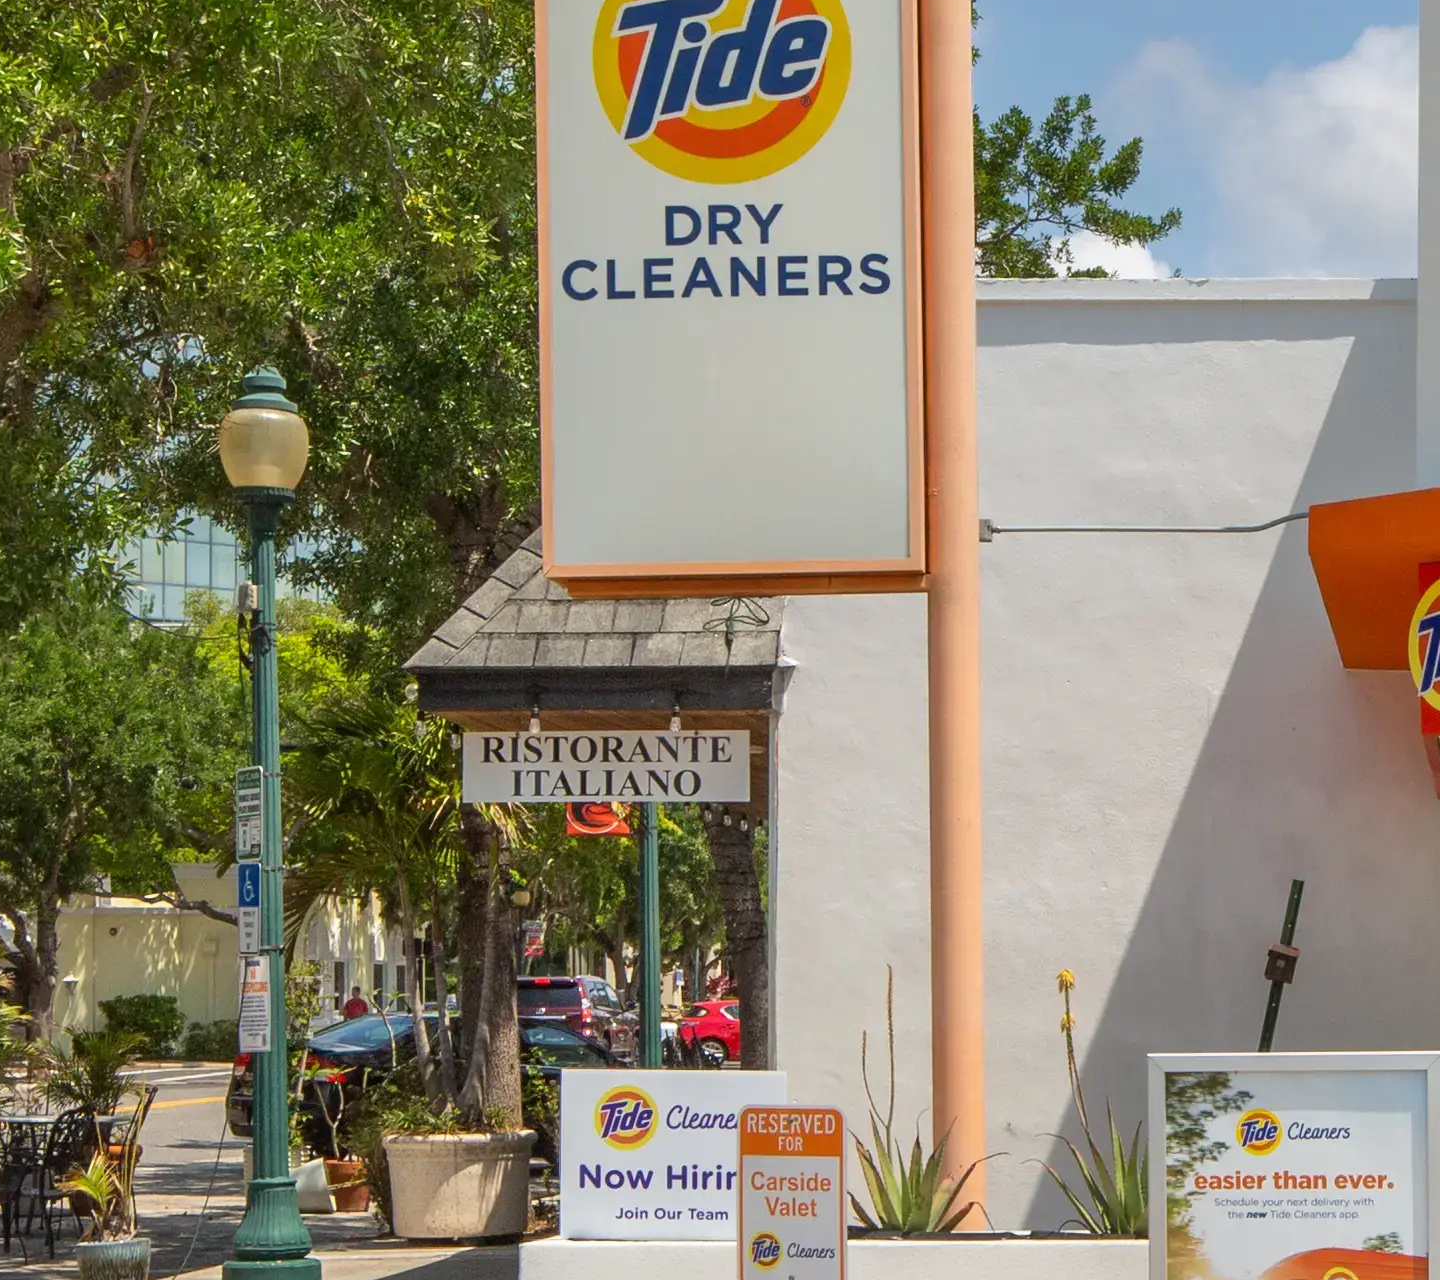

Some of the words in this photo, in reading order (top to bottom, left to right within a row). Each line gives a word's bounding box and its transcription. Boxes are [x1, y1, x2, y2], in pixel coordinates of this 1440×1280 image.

[664, 204, 784, 247] DRY
[562, 253, 891, 301] CLEANERS
[481, 735, 733, 764] RISTORANTE
[512, 769, 702, 797] ITALIANO
[600, 1100, 654, 1139] Tide
[666, 1104, 738, 1130] Cleane
[747, 1113, 836, 1135] RESERVED
[778, 1136, 804, 1151] FOR
[1240, 1119, 1279, 1147] Tide
[1287, 1122, 1351, 1140] Cleaners
[579, 1163, 654, 1190] Now
[751, 1171, 832, 1193] Carside
[1194, 1170, 1266, 1190] easier
[1273, 1170, 1327, 1190] than
[1334, 1174, 1395, 1190] ever.
[615, 1207, 648, 1220] Join
[654, 1207, 683, 1220] Our
[688, 1208, 729, 1221] Team
[765, 1196, 818, 1218] Valet
[1214, 1197, 1259, 1207] Schedule
[1262, 1199, 1284, 1208] your
[1286, 1198, 1308, 1207] next
[1311, 1197, 1350, 1208] delivery
[1353, 1197, 1374, 1207] with
[1228, 1210, 1244, 1219] the
[1246, 1211, 1268, 1219] new
[1270, 1210, 1291, 1219] Tide
[1294, 1210, 1336, 1219] Cleaners
[752, 1239, 781, 1263] Tide
[787, 1242, 836, 1259] Cleaners
